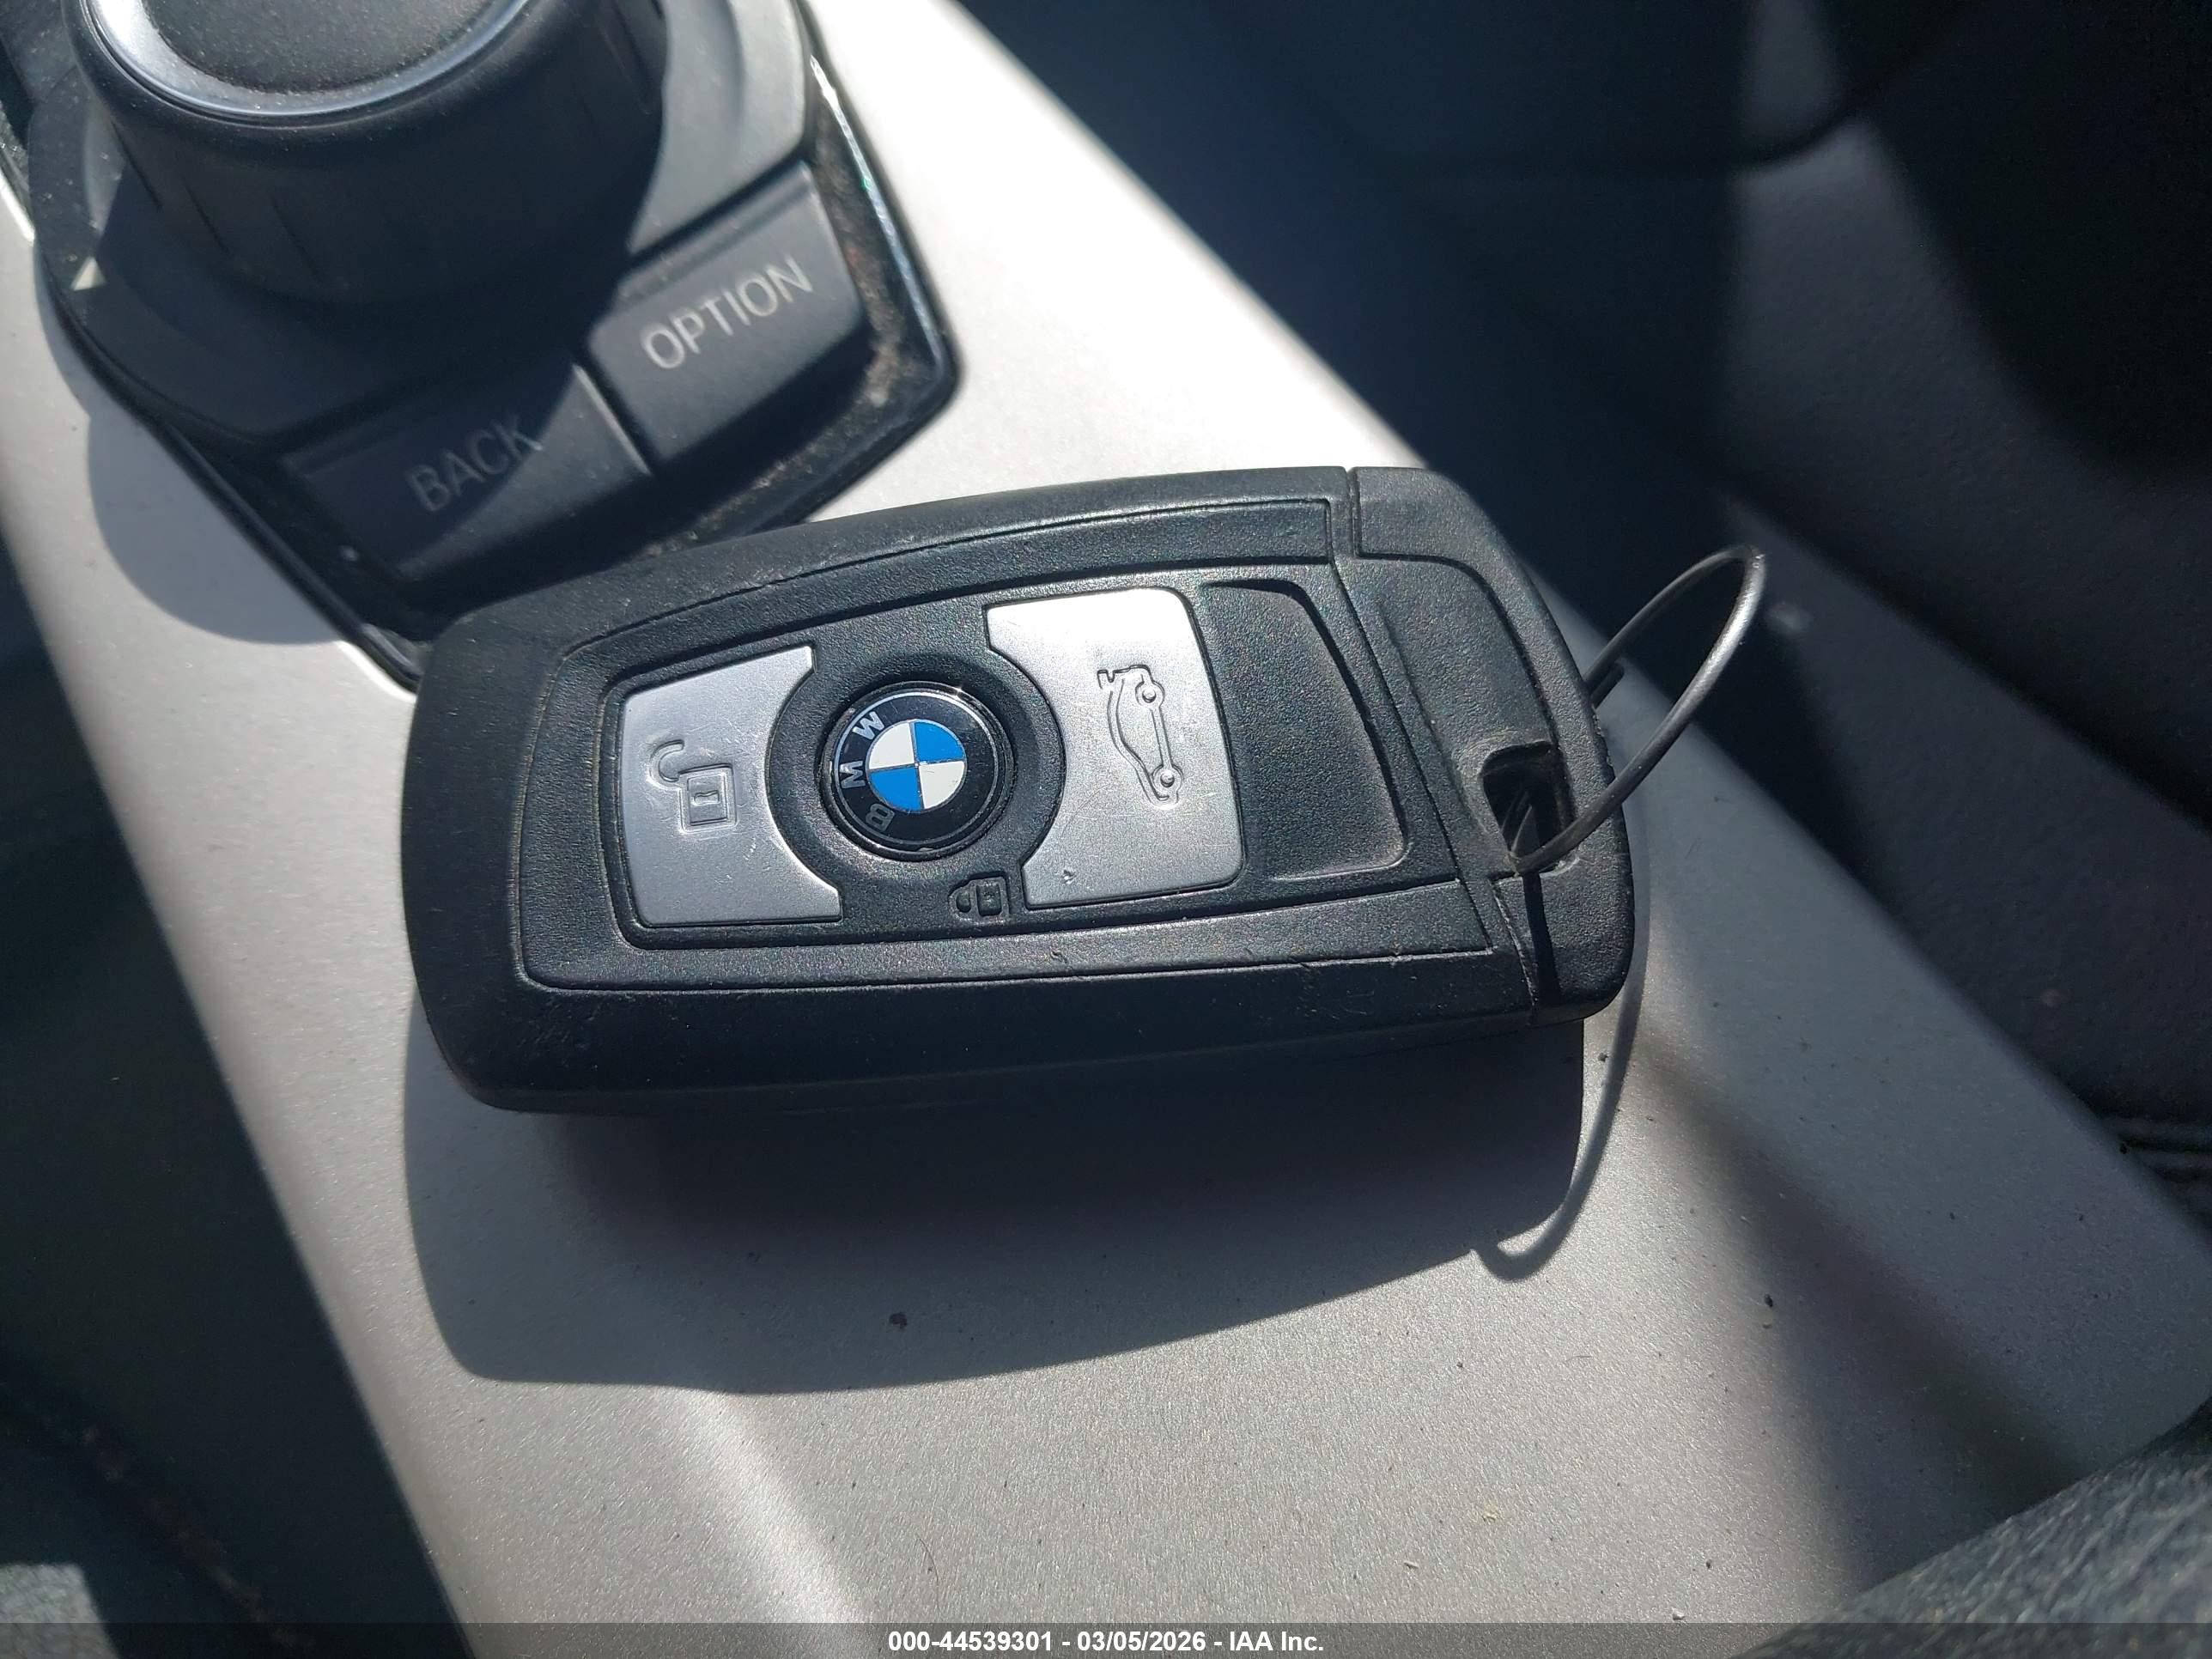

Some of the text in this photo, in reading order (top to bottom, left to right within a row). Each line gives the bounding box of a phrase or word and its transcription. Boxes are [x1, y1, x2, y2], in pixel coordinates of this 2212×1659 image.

[641, 257, 815, 370] OPTION
[405, 415, 544, 513] BACK
[838, 711, 896, 832] BMW
